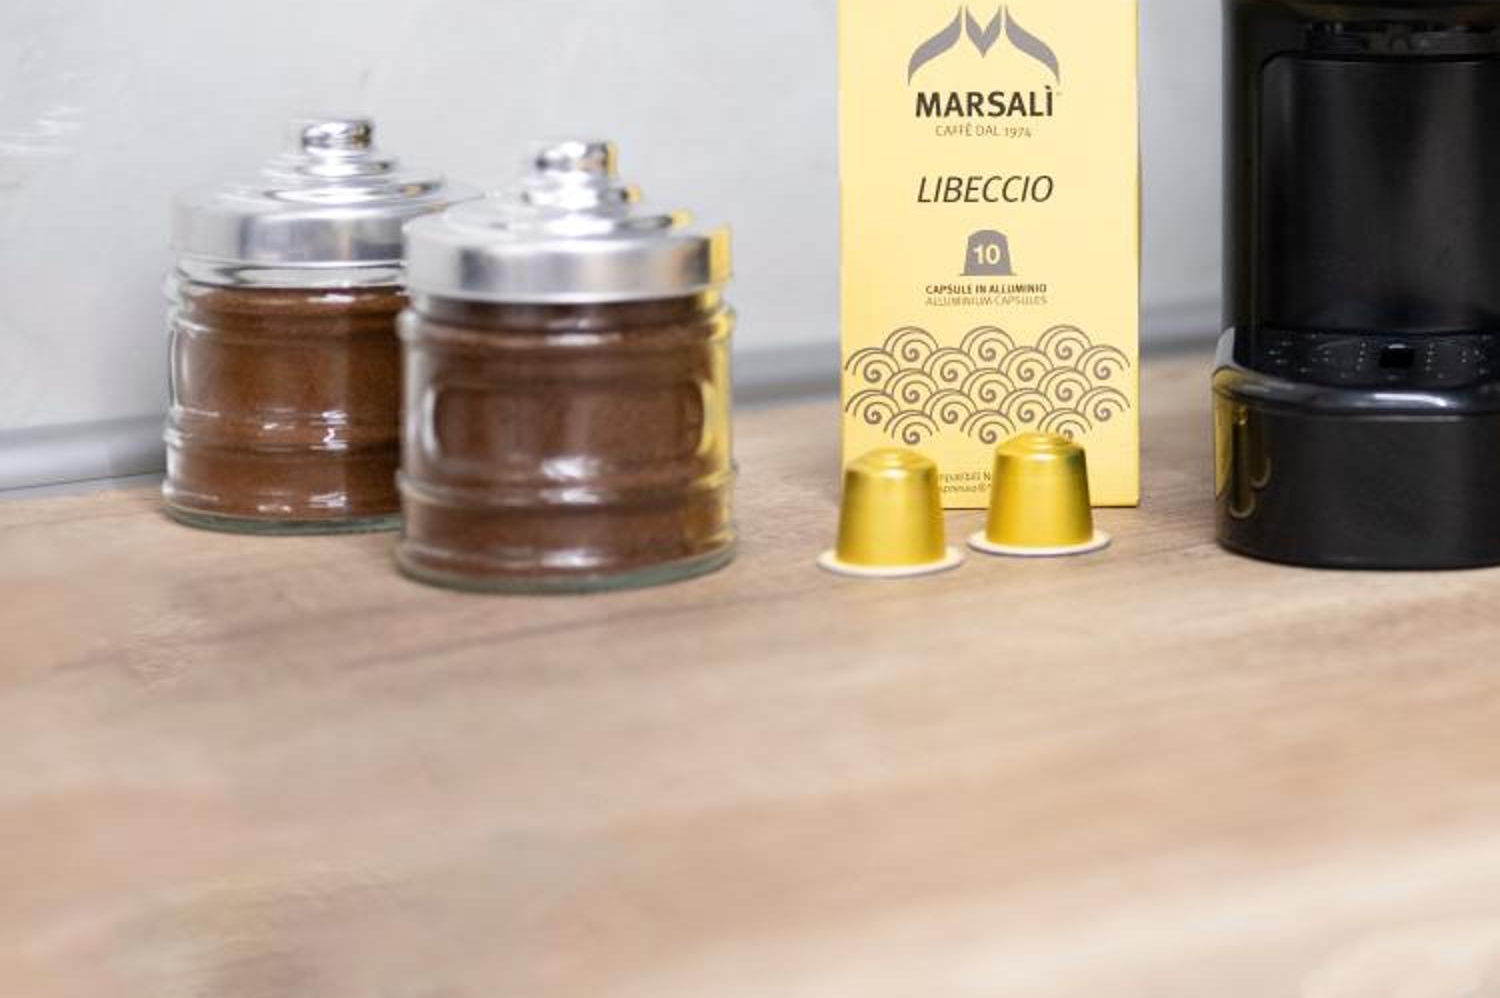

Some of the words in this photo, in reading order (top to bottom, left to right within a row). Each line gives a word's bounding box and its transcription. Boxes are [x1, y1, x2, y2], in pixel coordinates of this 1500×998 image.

[915, 85, 1053, 118] MARSALÌ
[975, 124, 1001, 137] DAL
[917, 175, 1054, 203] LIBECCIO
[973, 243, 1001, 265] 10
[925, 283, 972, 295] CAPSULE
[975, 283, 987, 294] IN
[989, 282, 1047, 295] ALLUMINIO
